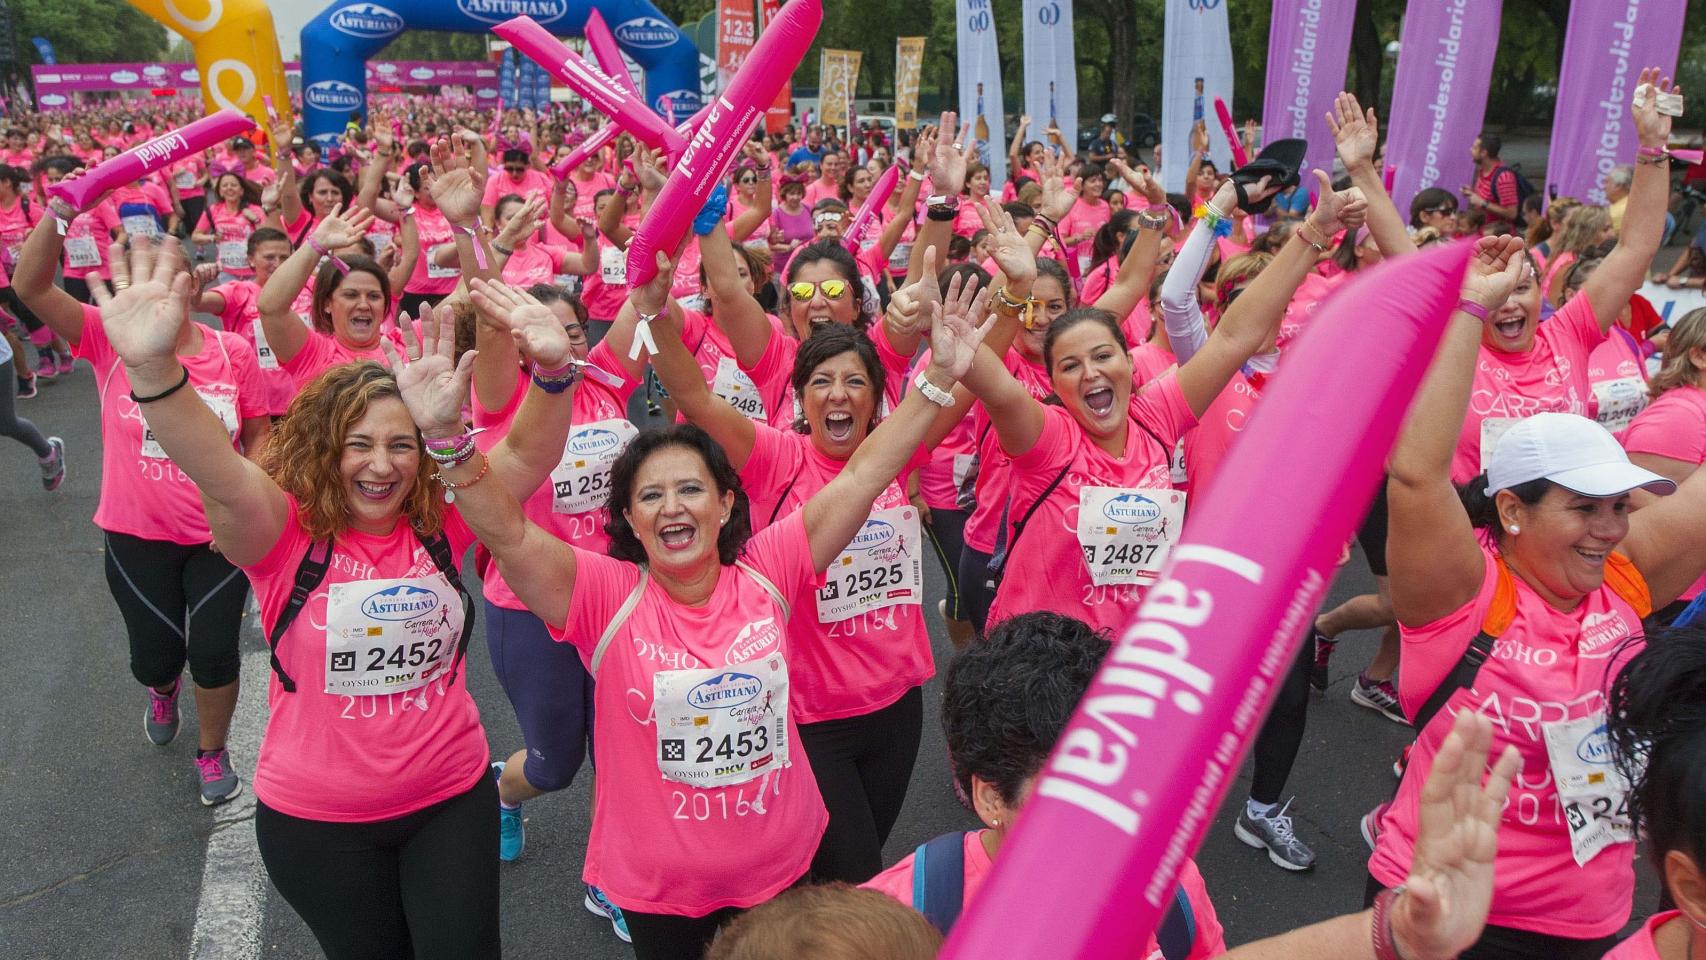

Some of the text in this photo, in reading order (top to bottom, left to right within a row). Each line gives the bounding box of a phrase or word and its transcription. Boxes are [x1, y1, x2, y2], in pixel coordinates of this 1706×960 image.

[336, 13, 399, 31] ASTURIANA
[621, 28, 675, 41] ASTURIANA
[308, 91, 360, 105] ASTURIANA
[731, 105, 756, 138] Protección
[676, 96, 734, 179] Ladival
[722, 137, 734, 154] solar
[134, 133, 189, 170] Ladival
[693, 161, 719, 196] profundidad
[731, 396, 764, 415] 2481
[571, 437, 616, 452] ASTURIANA
[578, 470, 613, 496] 252
[1108, 504, 1156, 517] ASTURIANA
[1102, 543, 1160, 565] 2487
[845, 563, 904, 597] 2525
[368, 598, 434, 615] ASTURIANA
[830, 602, 857, 615] OYSHO
[859, 592, 882, 605] DKV
[404, 619, 433, 629] Carrera
[365, 638, 443, 672] 2452
[342, 678, 379, 687] OYSHO
[384, 672, 416, 684] DKV
[1035, 543, 1265, 836] Ladival
[693, 685, 757, 704] ASTURIANA
[695, 725, 769, 764] 2453
[674, 763, 745, 779] OYSHO DKV
[672, 788, 750, 821] 2016
